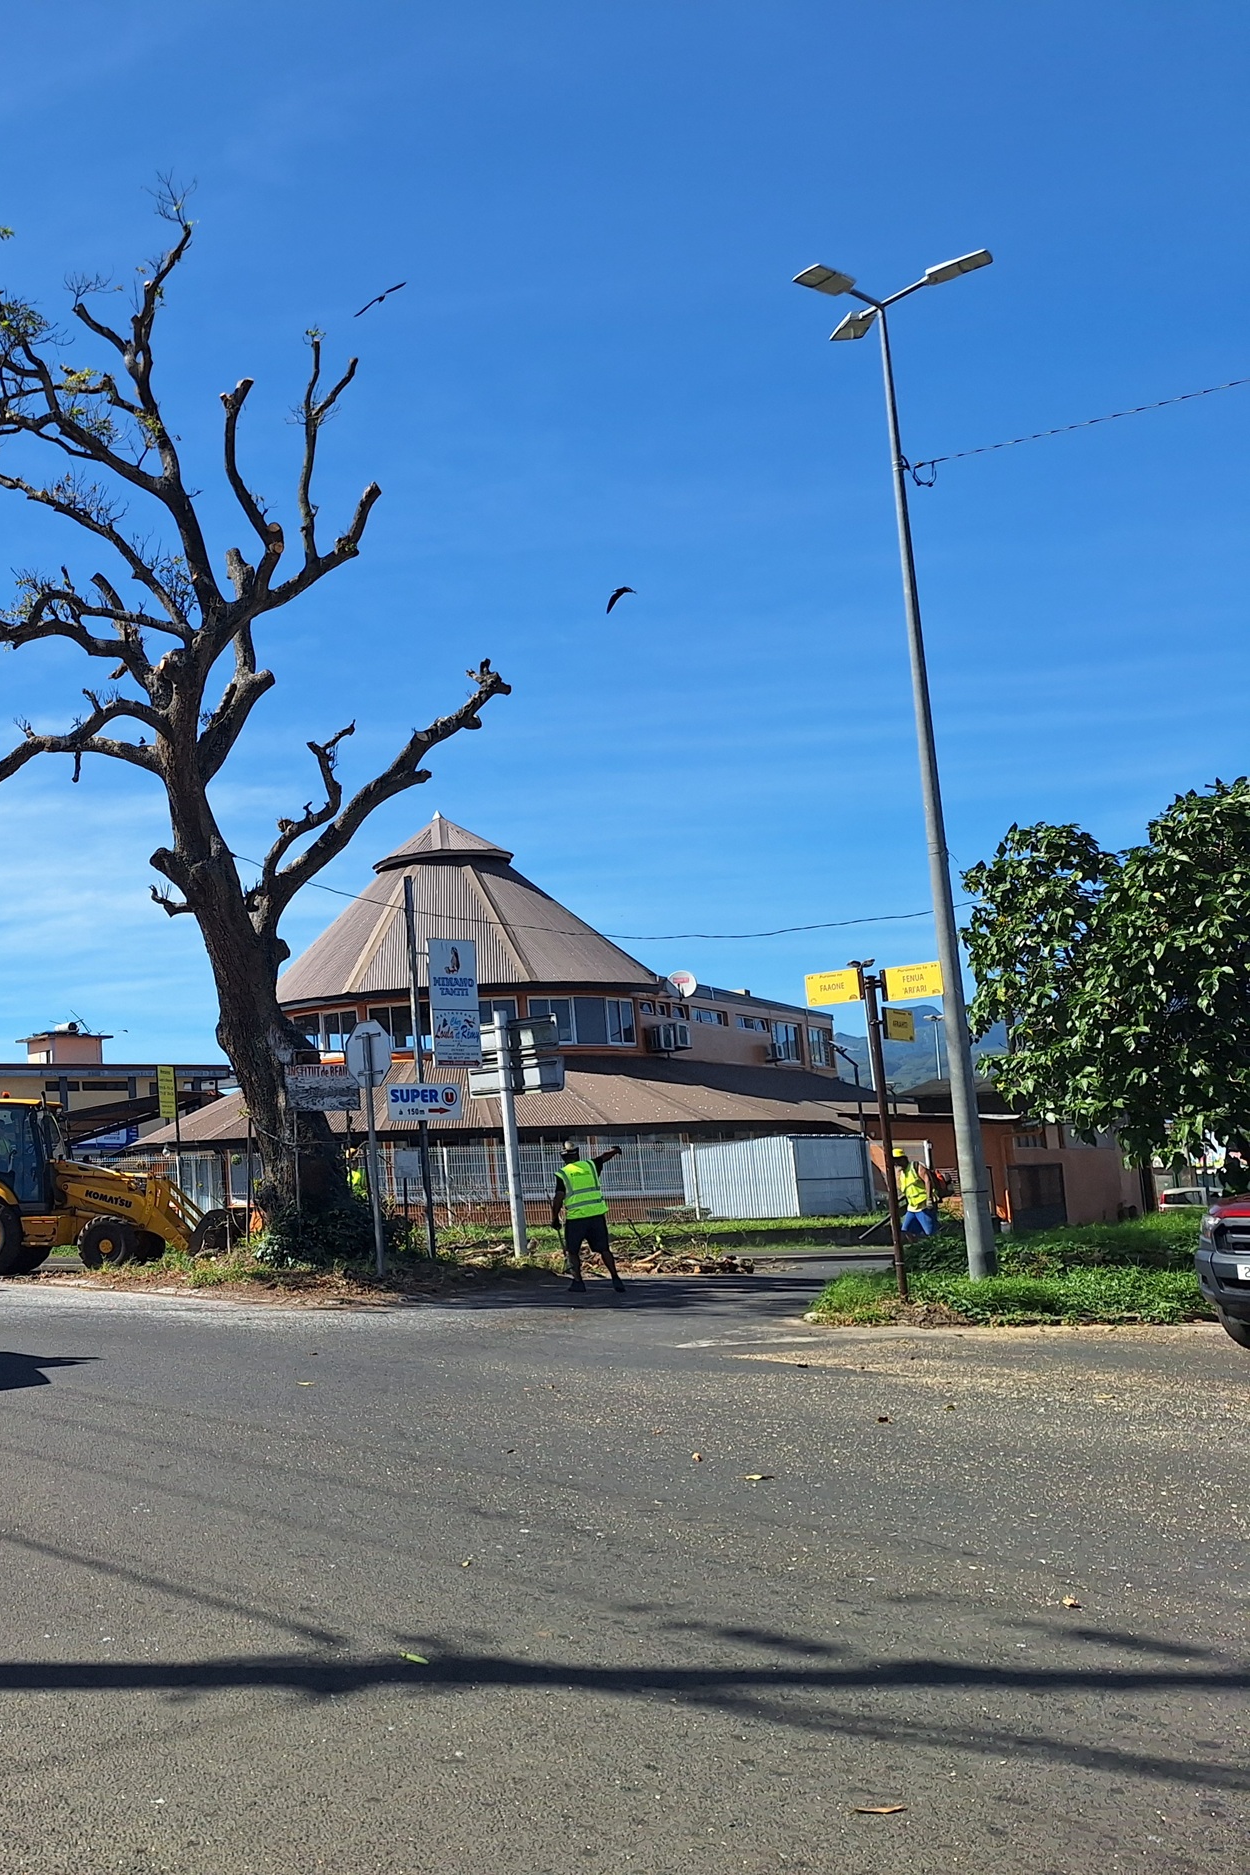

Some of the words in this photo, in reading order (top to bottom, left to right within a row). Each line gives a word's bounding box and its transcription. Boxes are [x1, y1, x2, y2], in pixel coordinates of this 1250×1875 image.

[902, 973, 925, 983] FENUA
[330, 1066, 348, 1078] BEAU
[390, 1089, 439, 1103] SUPER
[85, 1190, 132, 1208] KOMATSU
